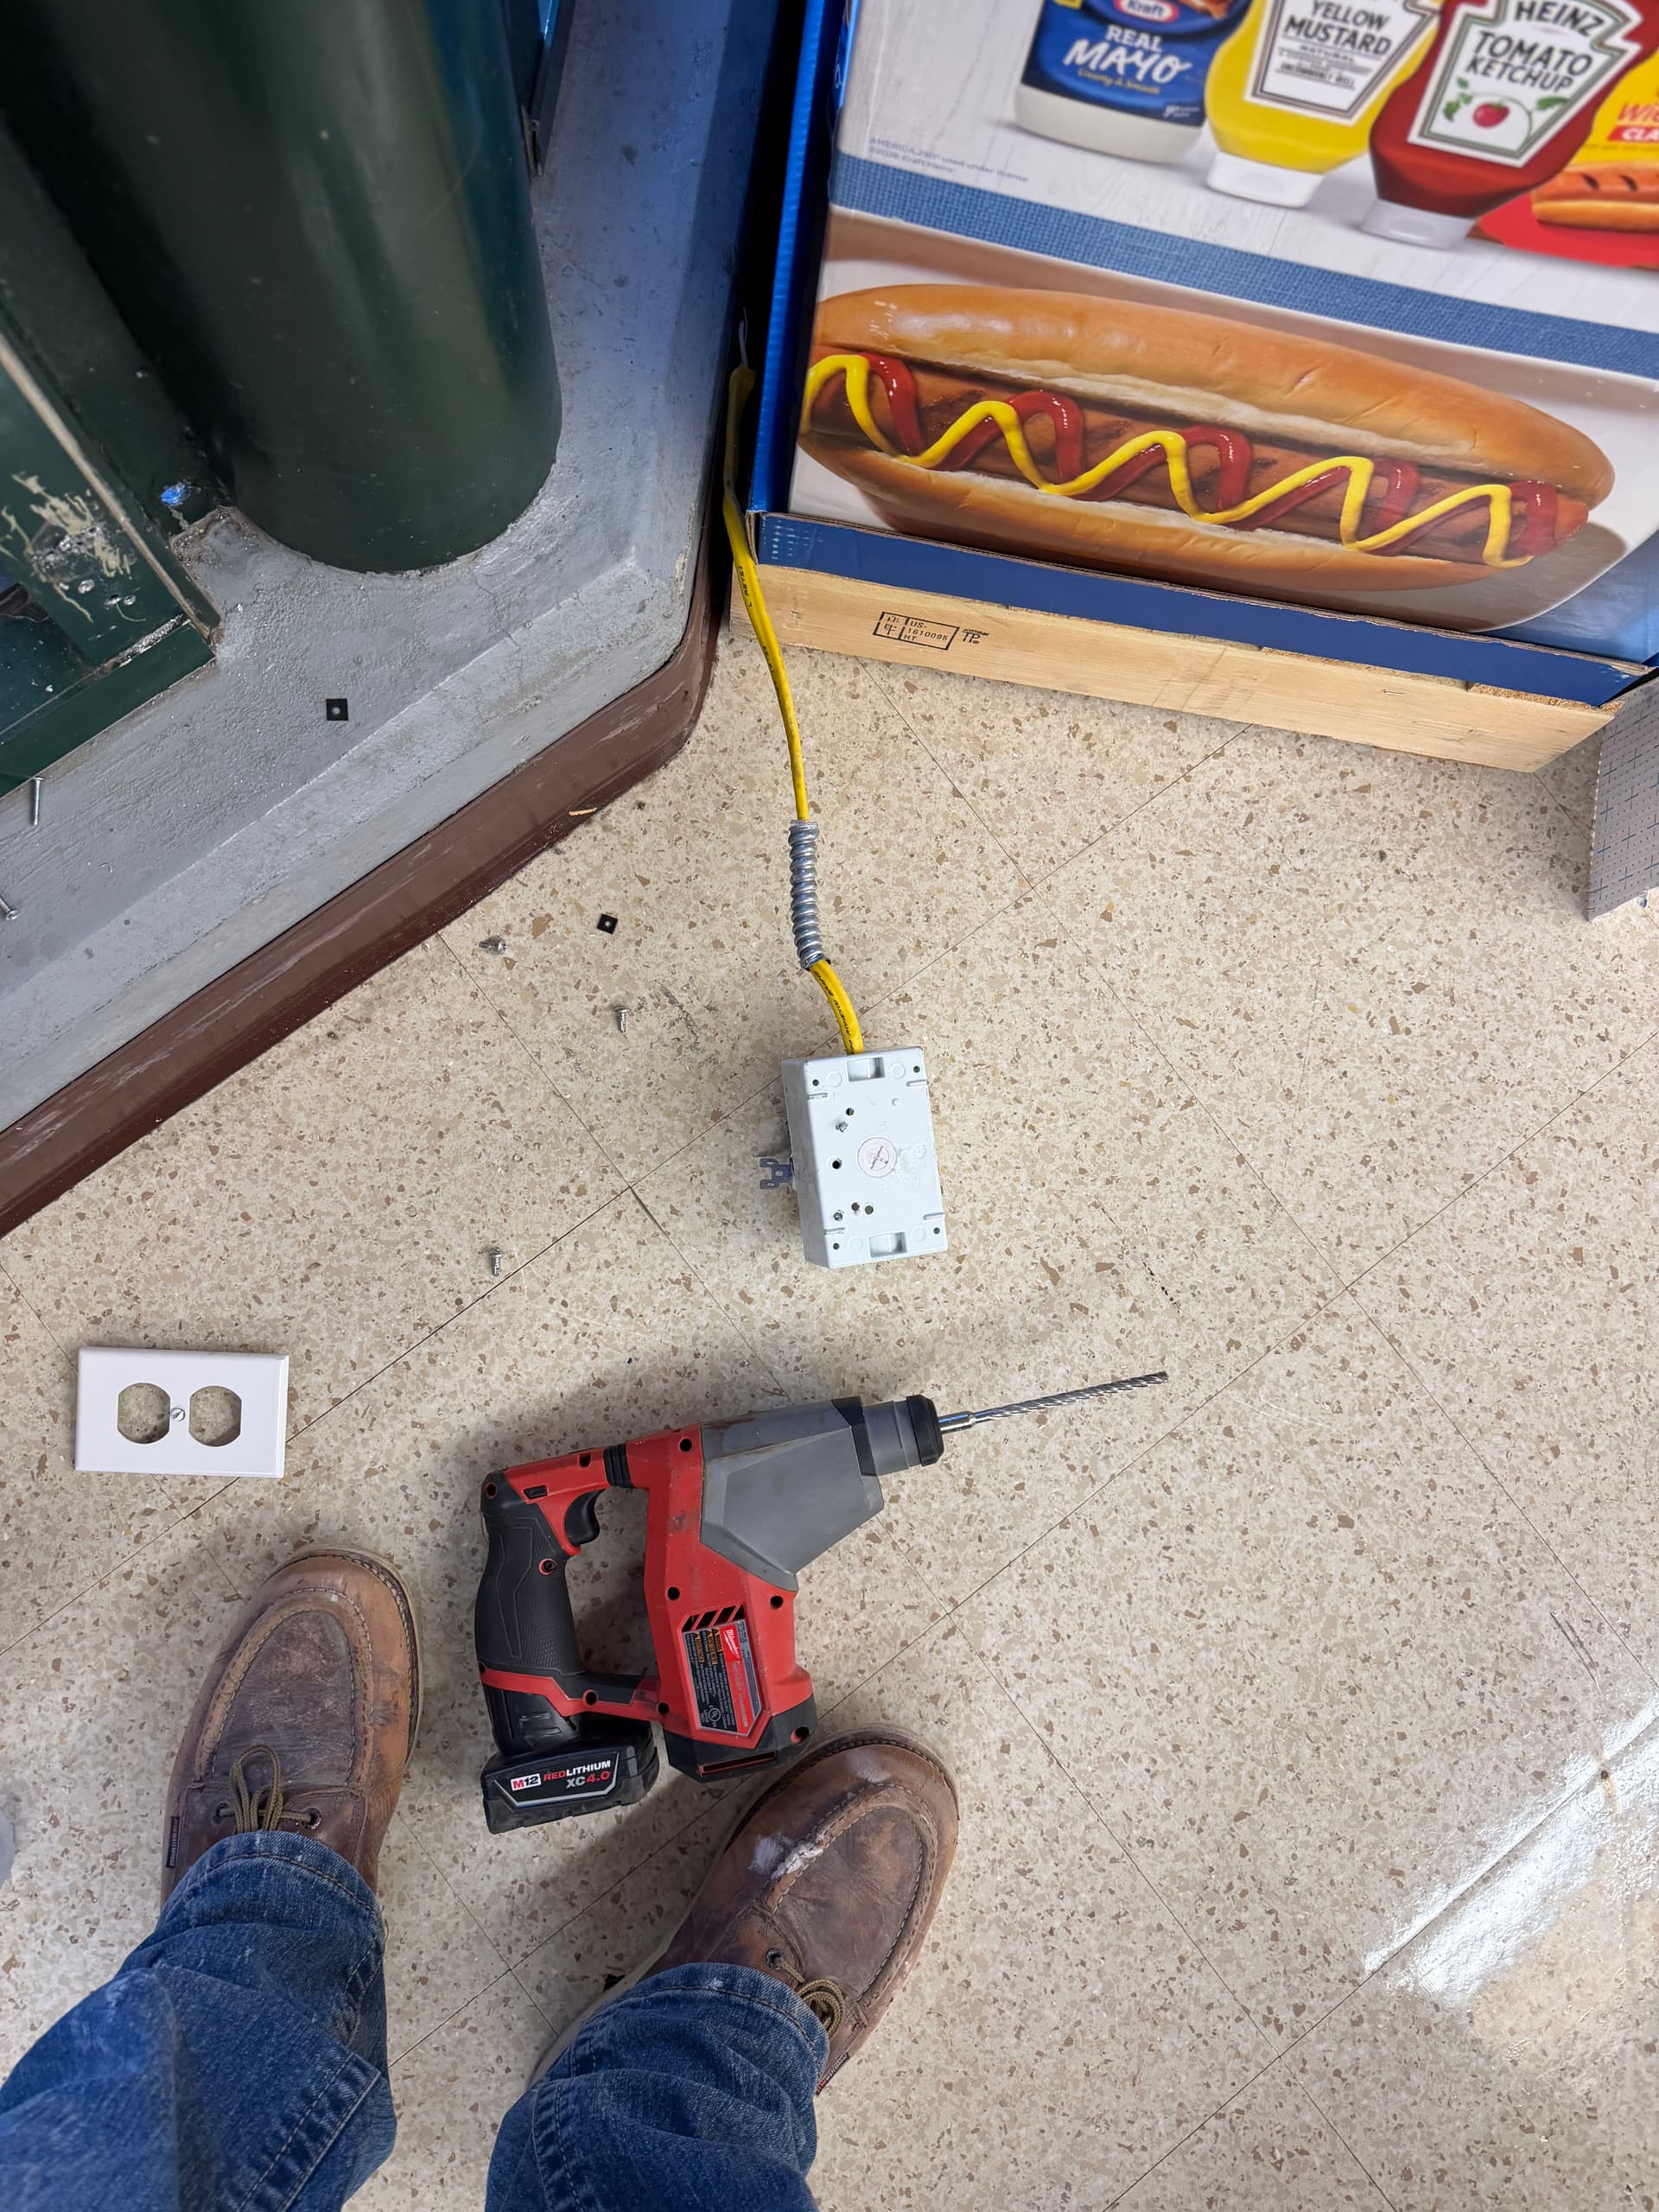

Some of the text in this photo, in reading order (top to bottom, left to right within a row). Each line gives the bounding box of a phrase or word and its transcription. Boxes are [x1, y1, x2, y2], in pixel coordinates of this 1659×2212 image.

[1313, 0, 1389, 30] YELLOW
[1514, 1, 1605, 37] HEINZ
[1105, 24, 1163, 53] REAL
[1284, 15, 1393, 55] MUSTARD
[1063, 39, 1193, 83] MAYO
[1472, 30, 1592, 76] TOMATO
[1465, 57, 1574, 92] KETCHUP
[907, 627, 948, 641] 1610095
[512, 1759, 612, 1790] M12 REDLITHIUM
[566, 1770, 611, 1790] XC4.0
